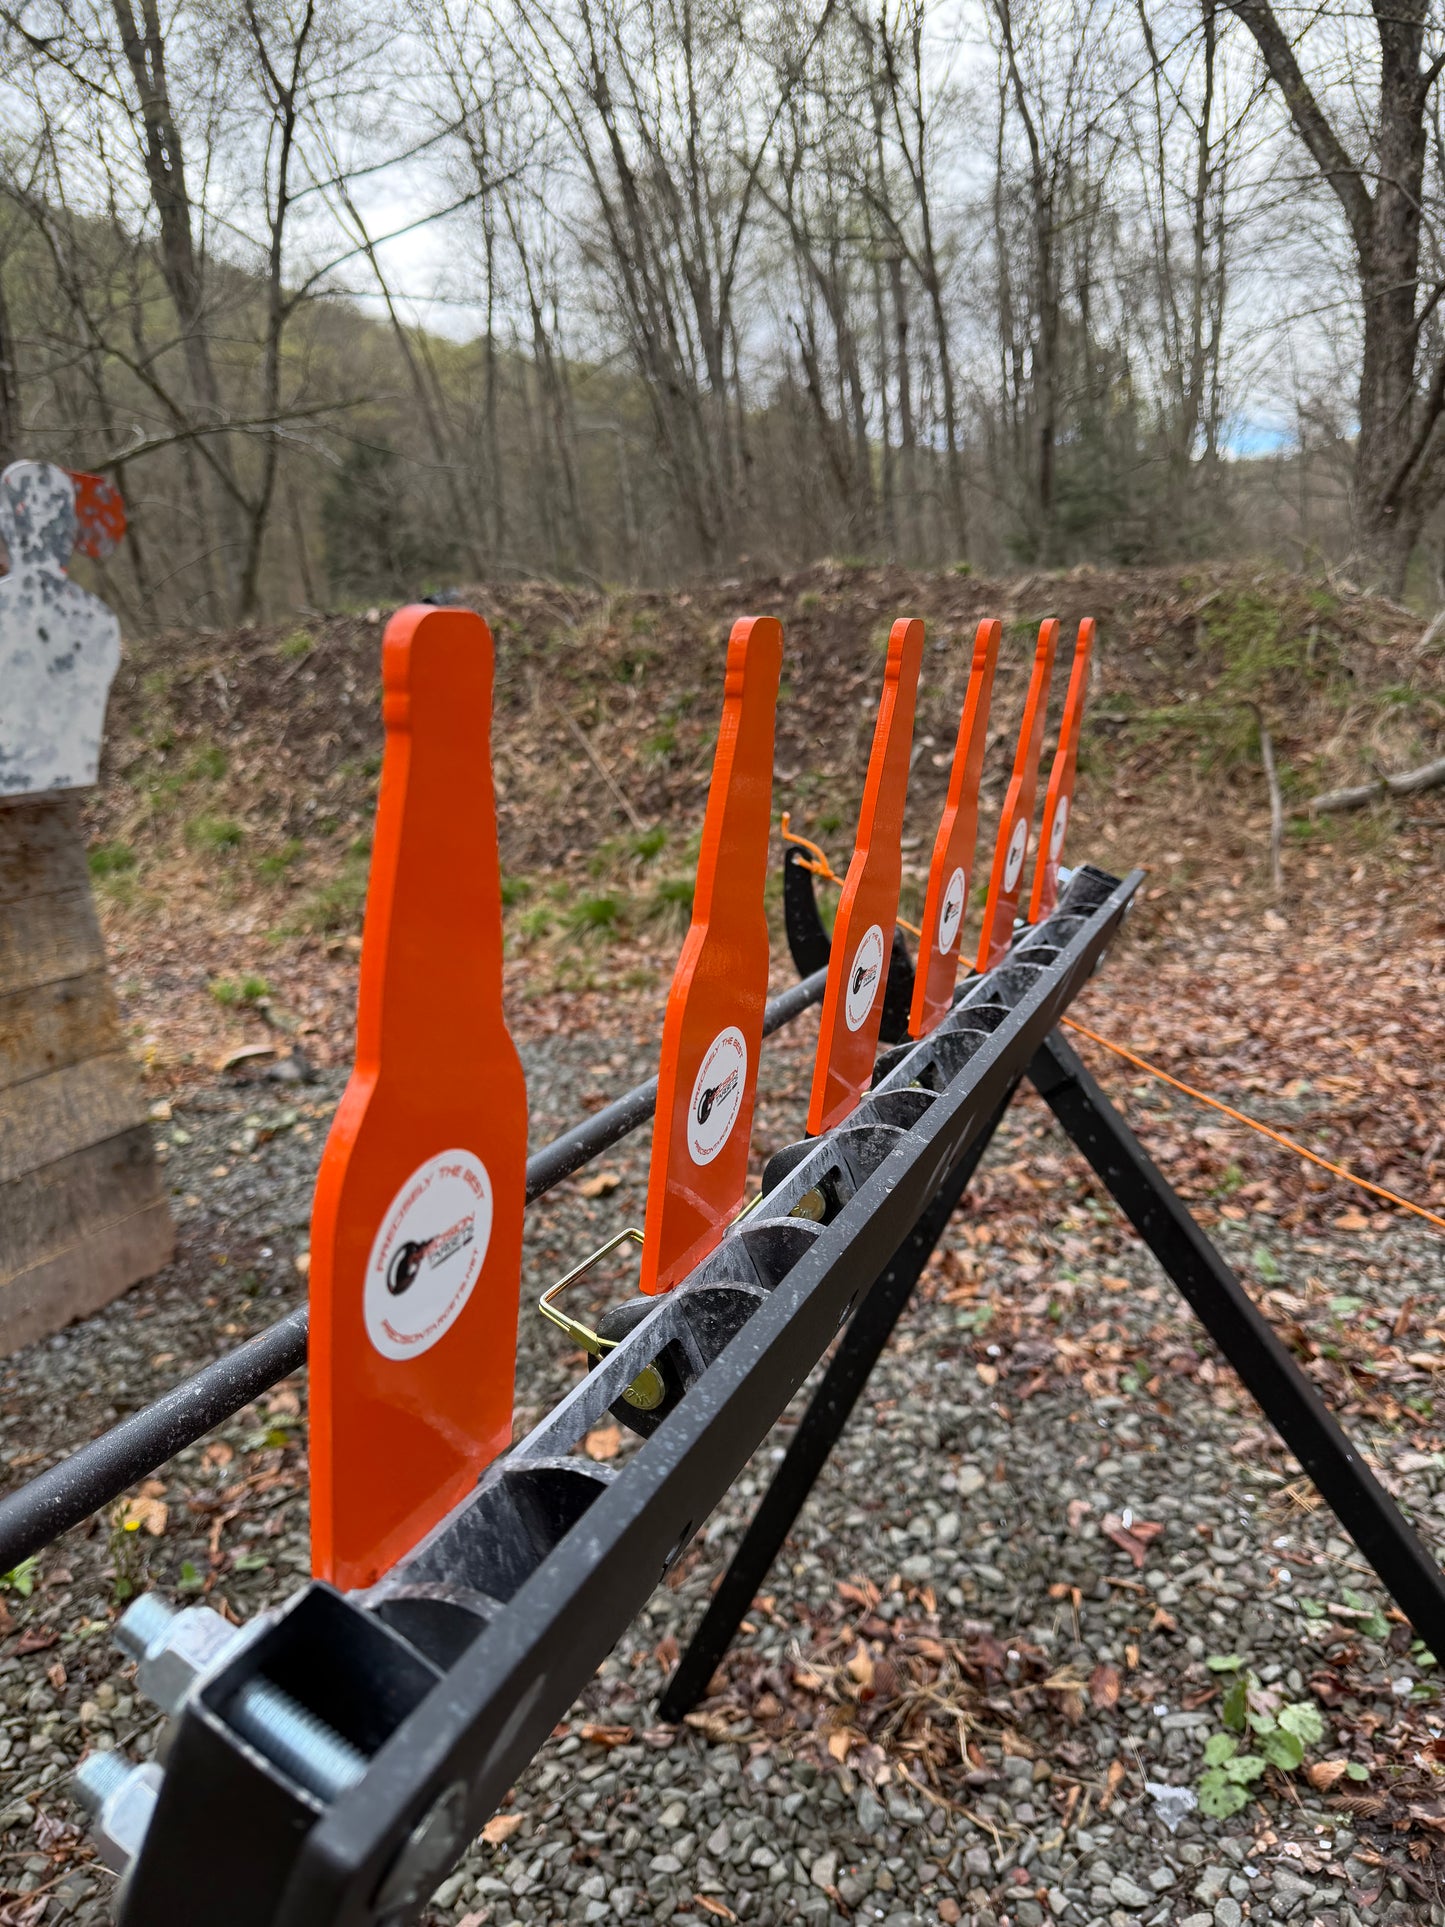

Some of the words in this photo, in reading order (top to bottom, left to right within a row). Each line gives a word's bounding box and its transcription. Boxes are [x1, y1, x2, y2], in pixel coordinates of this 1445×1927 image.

[721, 1036, 733, 1048] THE
[732, 1037, 743, 1058] BEST
[376, 1172, 434, 1273] PRECISELY
[438, 1164, 464, 1180] THE
[463, 1167, 486, 1201] BEST
